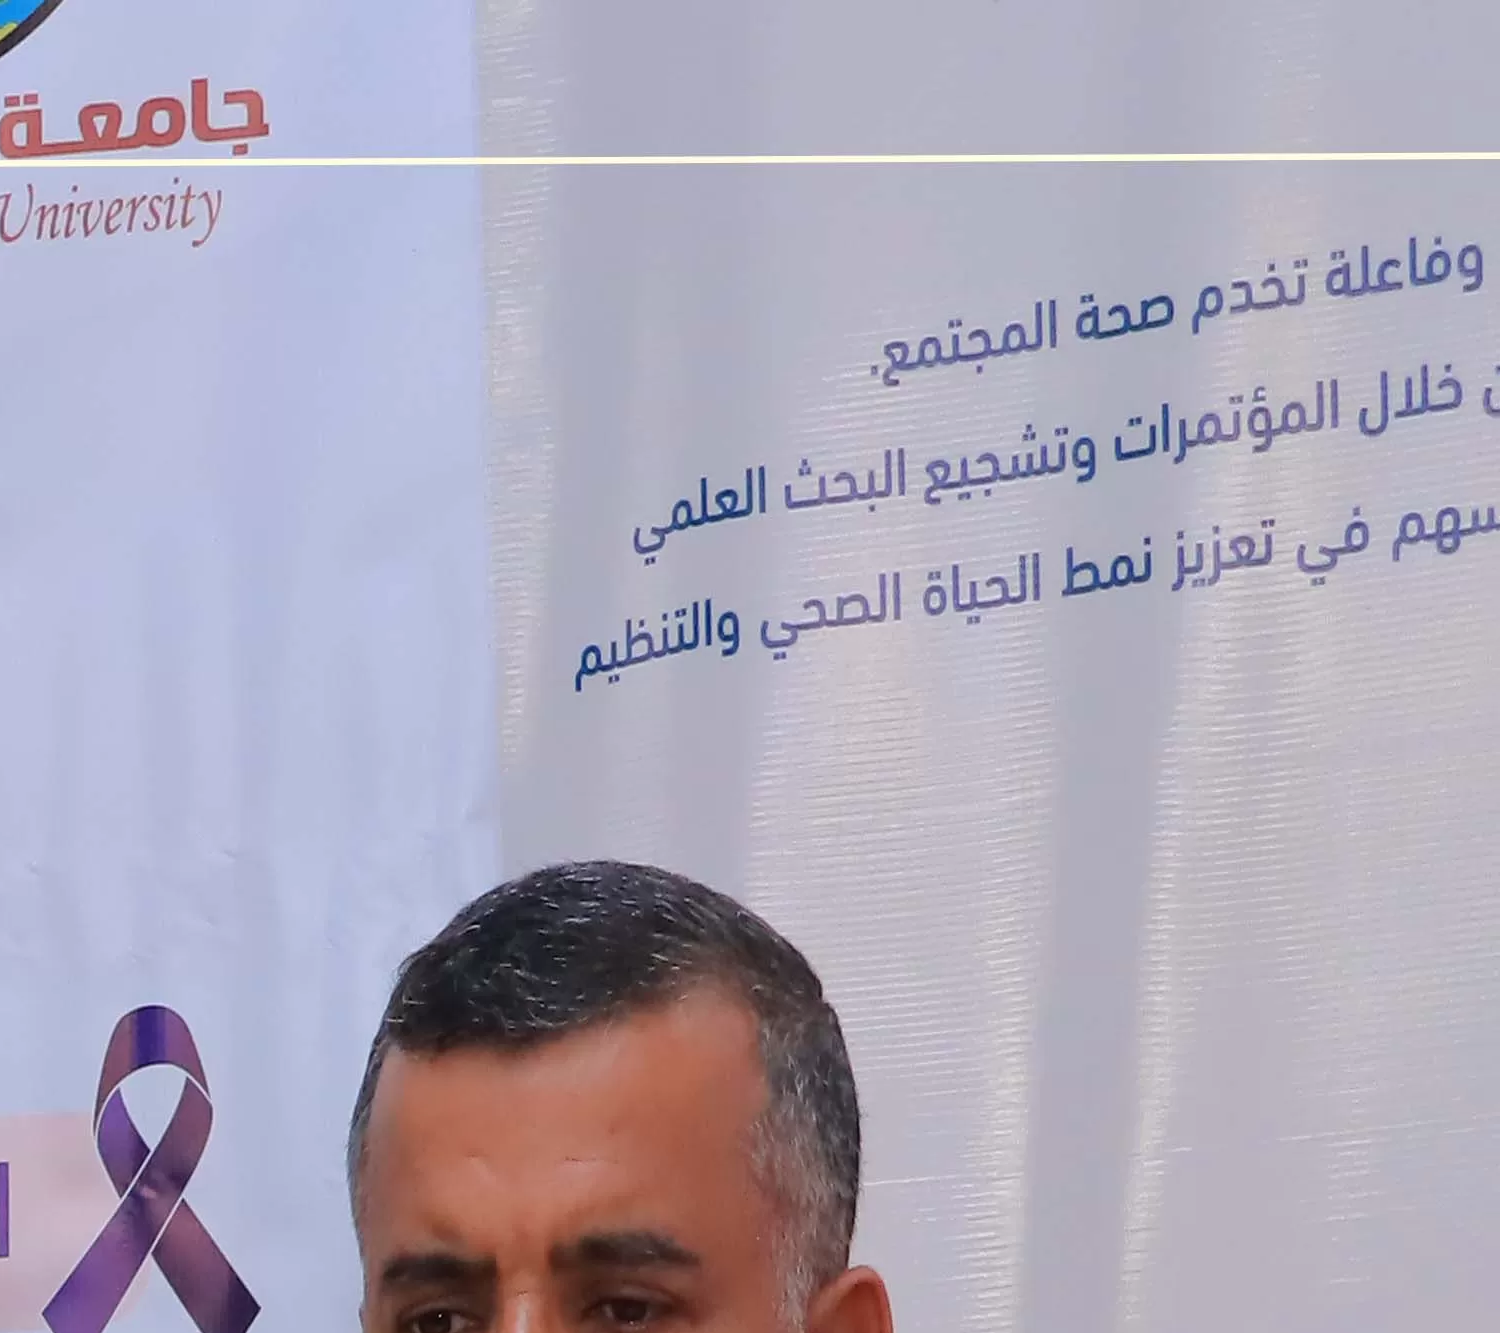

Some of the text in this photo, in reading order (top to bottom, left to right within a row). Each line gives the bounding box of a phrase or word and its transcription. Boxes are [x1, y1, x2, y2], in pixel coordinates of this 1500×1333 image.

[1190, 258, 1309, 336] تخدم
[1325, 235, 1484, 299] وفاعلة
[1074, 292, 1175, 341] صحة
[1112, 378, 1341, 466] المؤتمرات
[1358, 364, 1464, 437] خلال
[783, 447, 907, 514] البحث
[922, 423, 1098, 506] وتشجيع
[632, 467, 768, 567] العلمي
[1171, 518, 1277, 592] تعزيز
[1296, 505, 1370, 589] في
[922, 553, 1041, 626] الحياة
[1062, 536, 1153, 598] نمط
[573, 599, 741, 692] والتنظيم
[758, 571, 902, 661] الصحي
